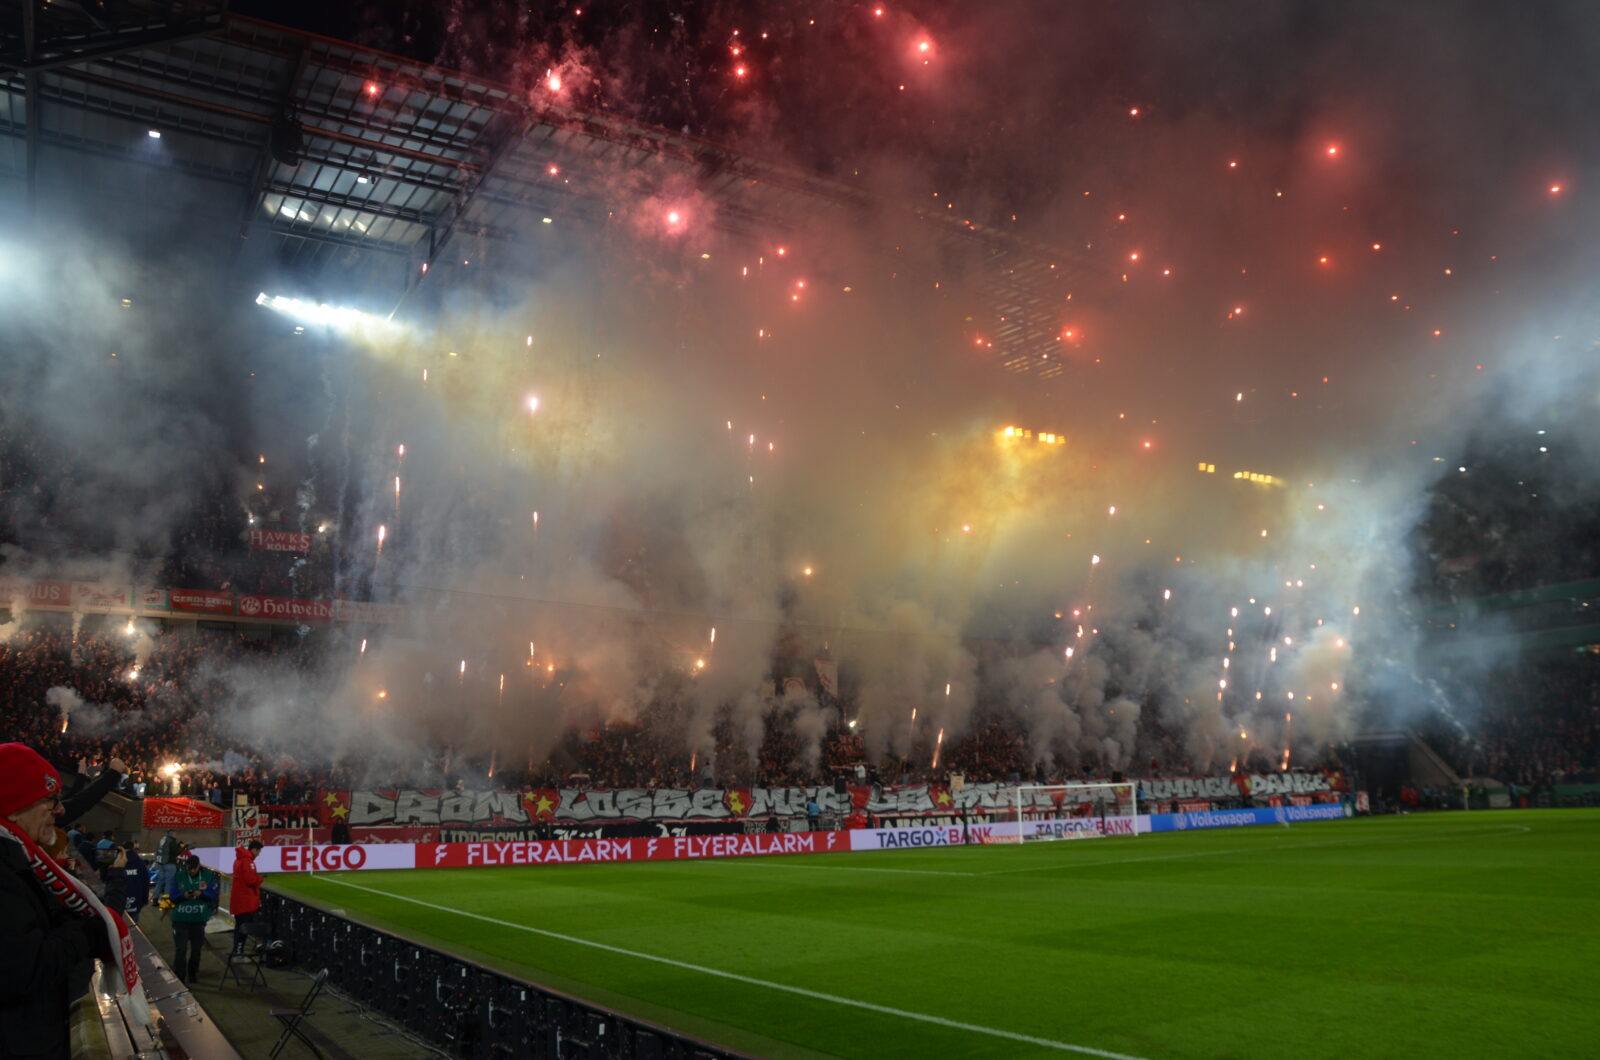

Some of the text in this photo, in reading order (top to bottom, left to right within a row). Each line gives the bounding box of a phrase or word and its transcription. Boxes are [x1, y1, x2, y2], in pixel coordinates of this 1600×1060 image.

[250, 530, 310, 550] HAWKS
[554, 788, 733, 821] LOSSE
[1286, 804, 1343, 820] Volkswagen
[1188, 811, 1256, 828] Volkswagen
[280, 845, 367, 871] ERGO
[468, 840, 632, 865] FLYERALARM
[674, 833, 814, 858] FLYERALARM
[178, 904, 205, 914] HOST
